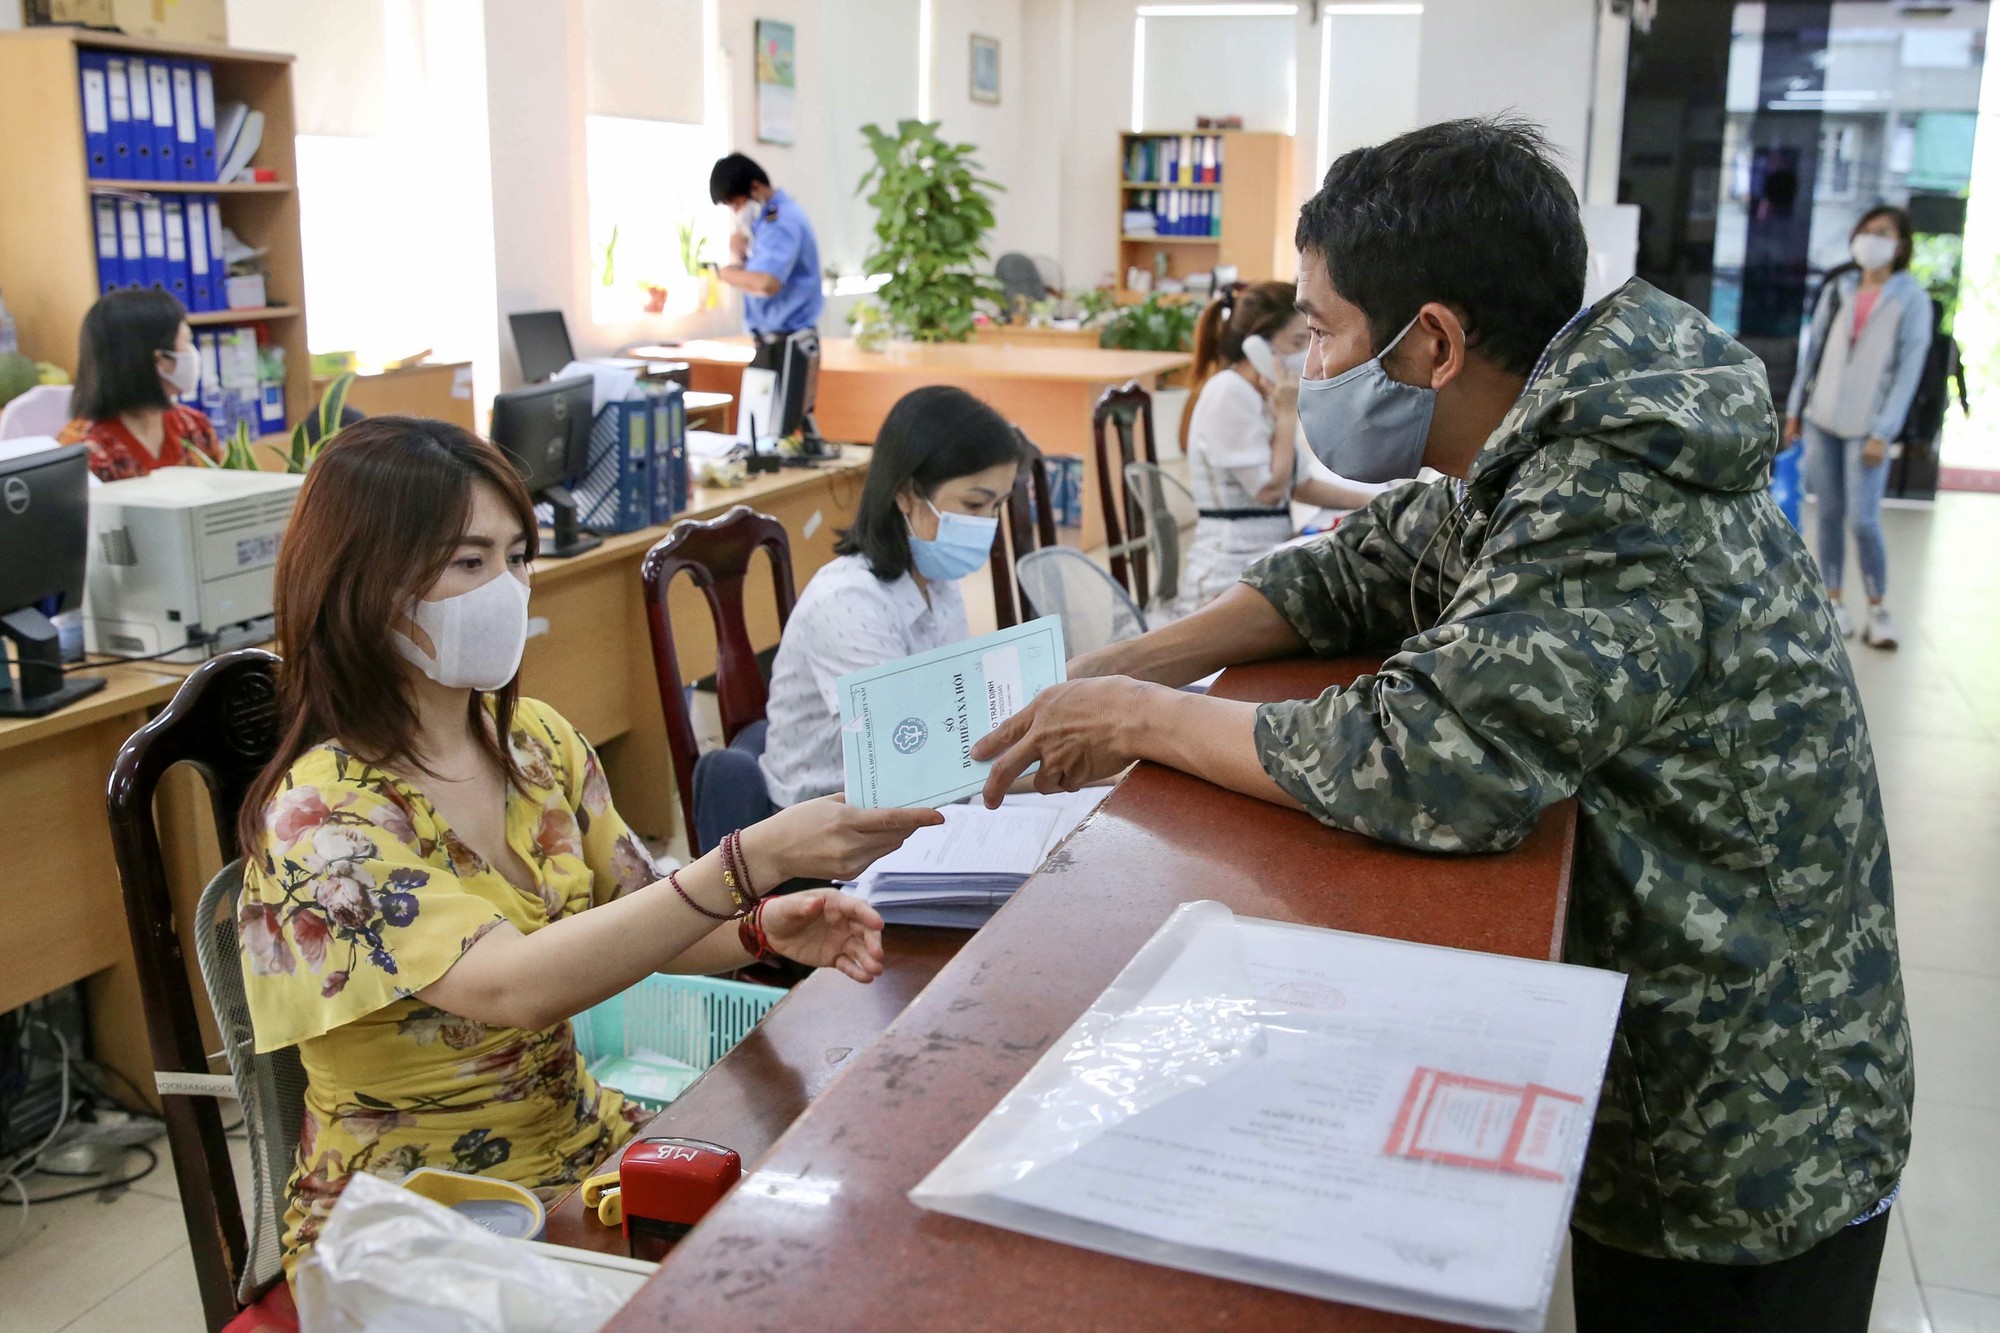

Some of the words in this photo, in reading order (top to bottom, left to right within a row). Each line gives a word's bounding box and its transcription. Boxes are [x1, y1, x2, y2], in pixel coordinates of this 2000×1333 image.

[952, 673, 965, 695] HỘI
[987, 680, 997, 700] ĐỊNH
[954, 696, 967, 713] XÃ
[956, 713, 969, 744] HIỂM
[959, 745, 971, 769] BẢO
[656, 1145, 698, 1162] MB
